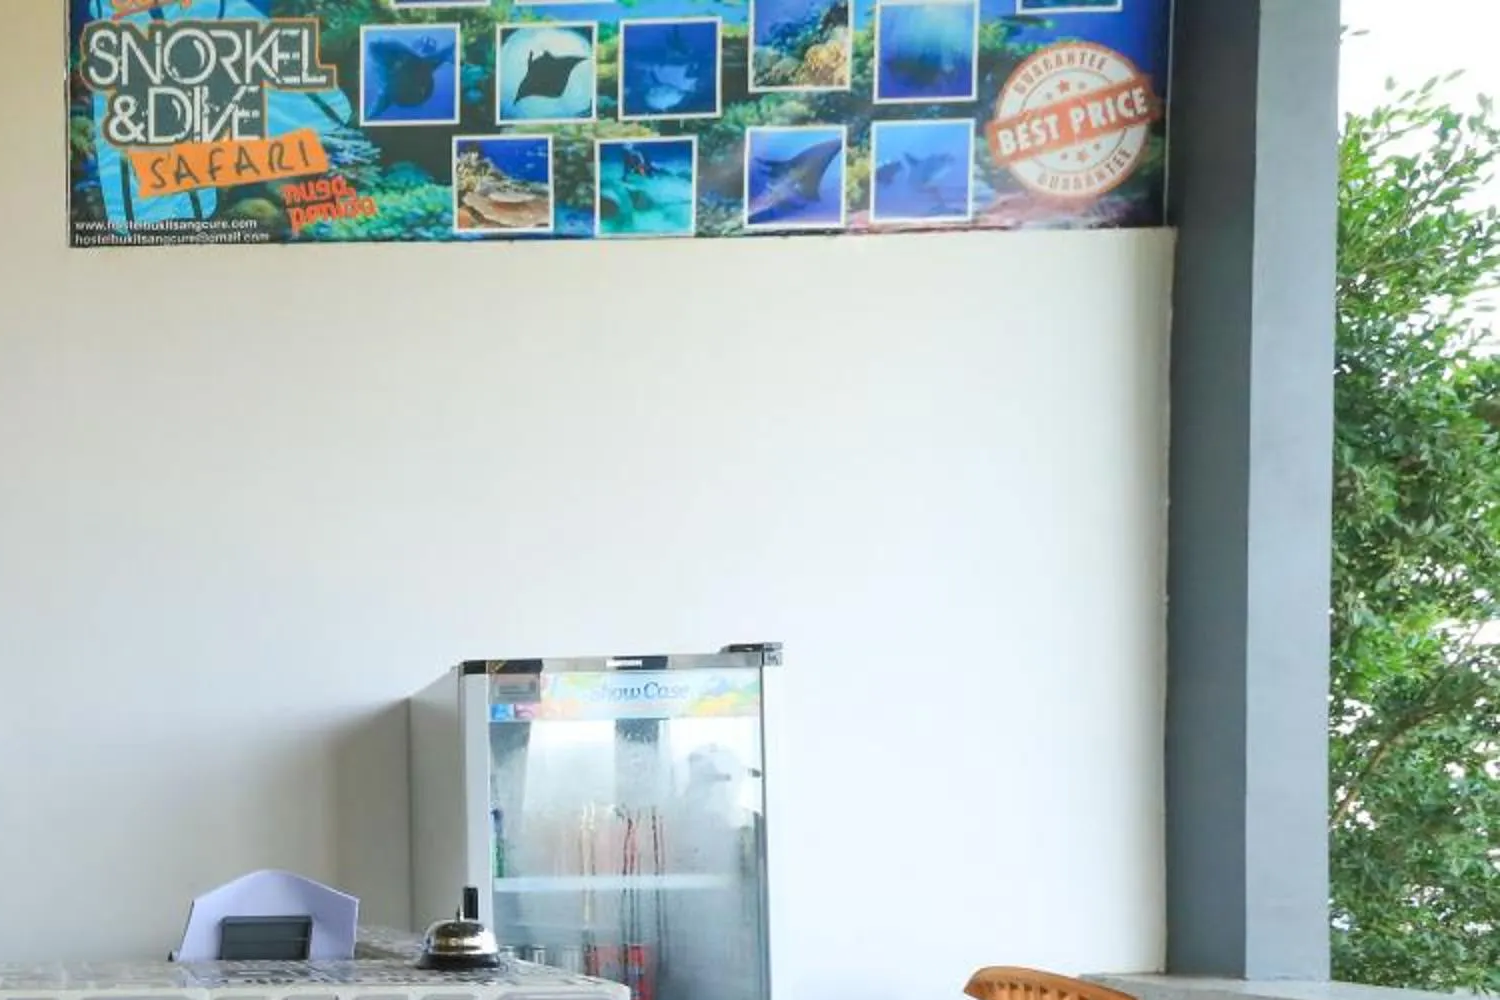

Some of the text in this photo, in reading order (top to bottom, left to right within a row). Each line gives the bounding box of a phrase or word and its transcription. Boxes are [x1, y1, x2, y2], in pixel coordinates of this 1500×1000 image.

[89, 28, 327, 85] SNORKEL
[997, 87, 1149, 156] BEST PRICE
[150, 141, 310, 189] SAFARI
